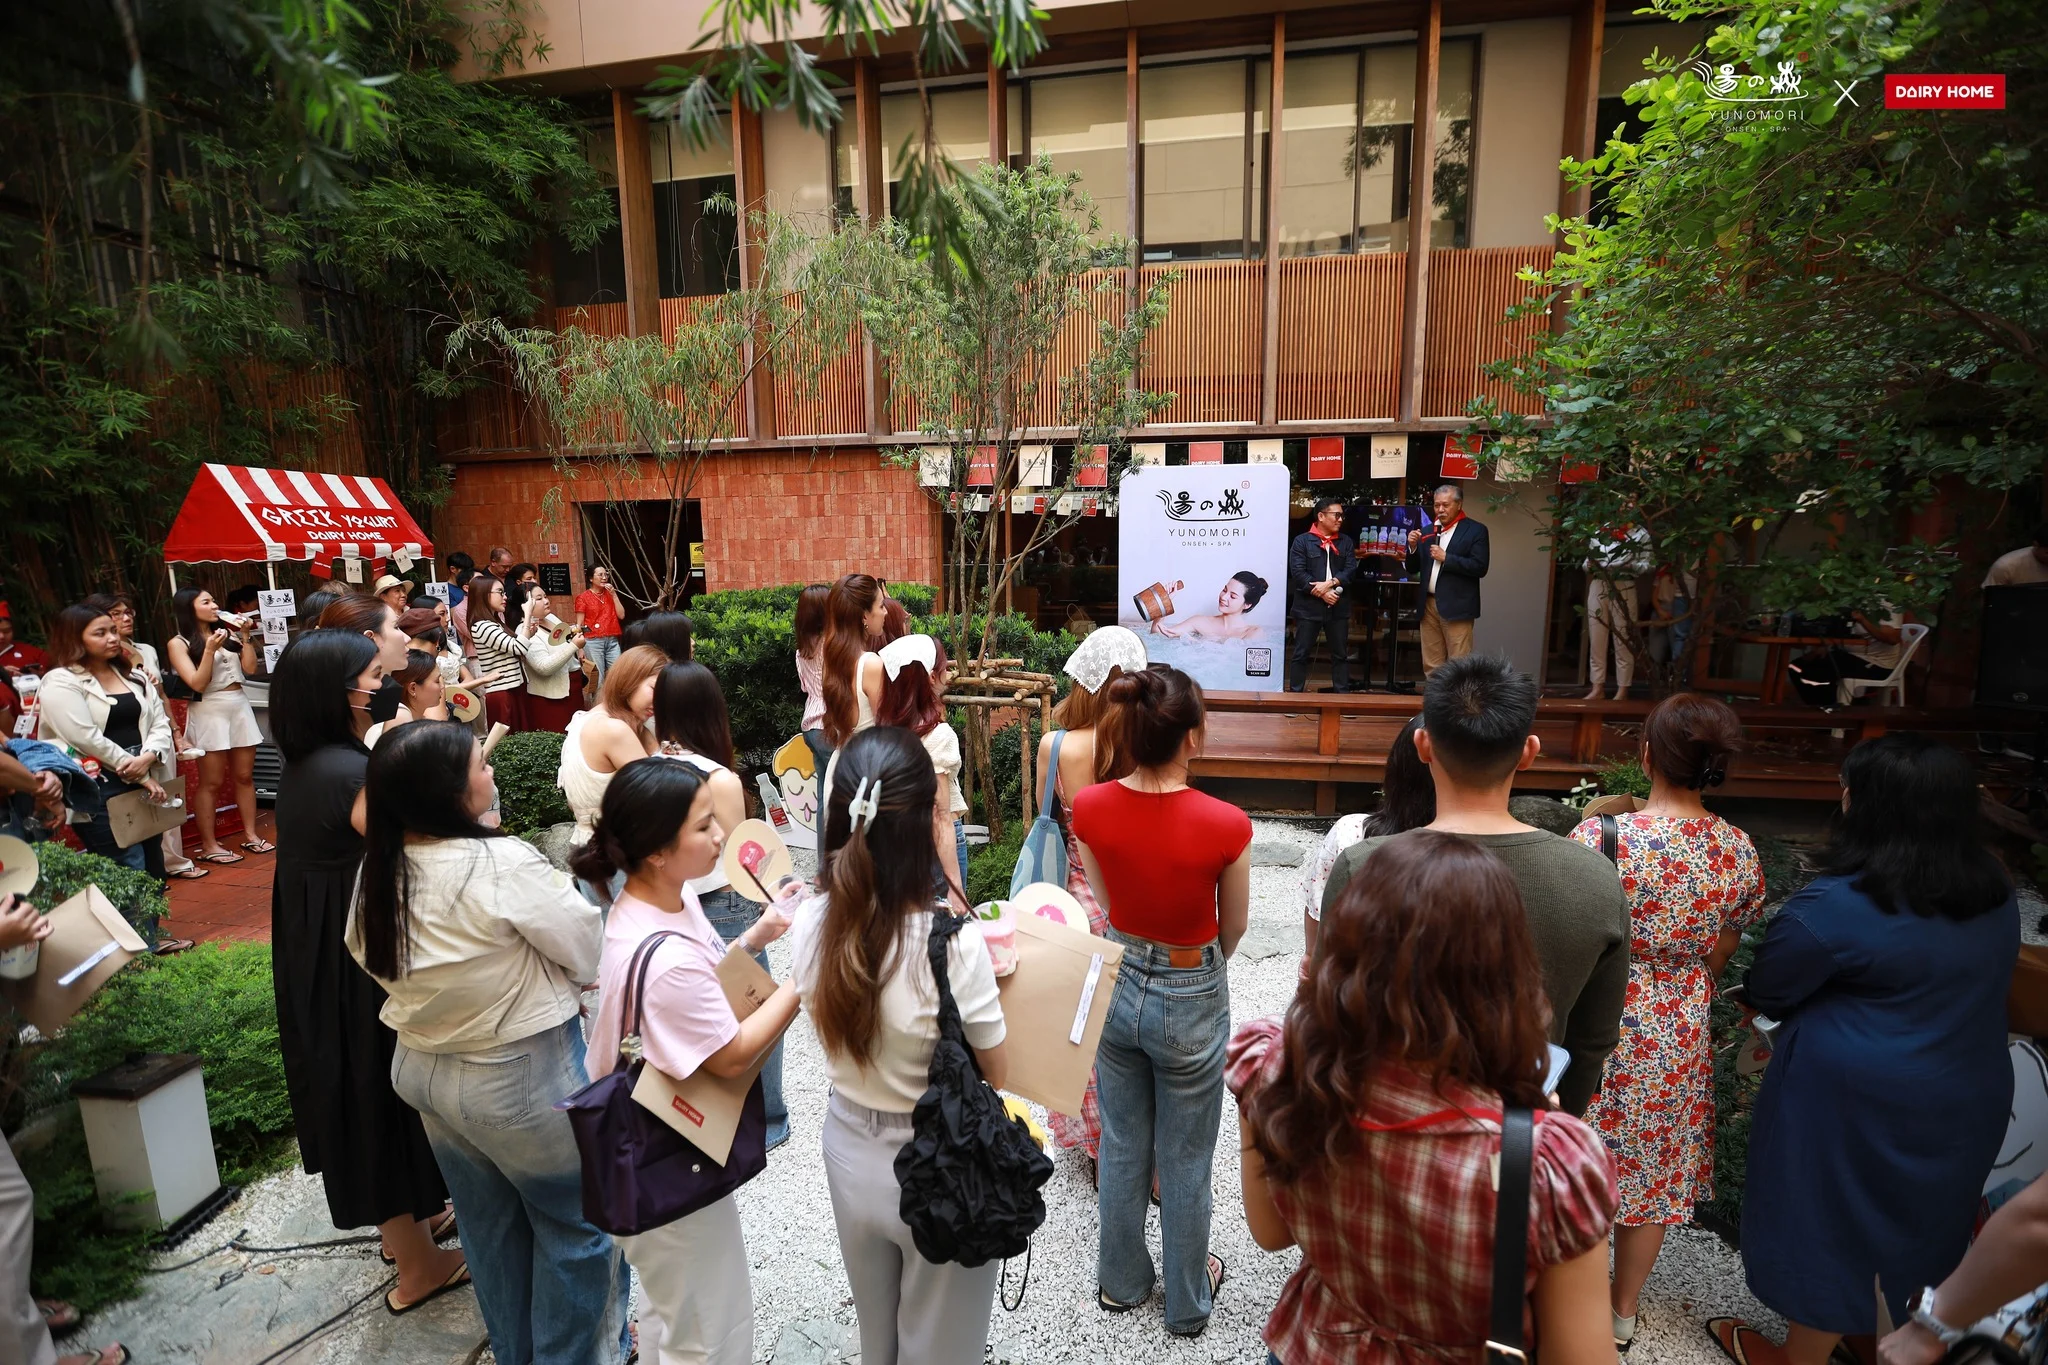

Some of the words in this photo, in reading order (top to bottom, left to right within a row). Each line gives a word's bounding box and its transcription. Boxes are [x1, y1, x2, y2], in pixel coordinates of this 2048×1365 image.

[306, 530, 345, 541] DAIRY
[346, 531, 385, 541] HOME
[1168, 528, 1246, 537] YUNOMORI
